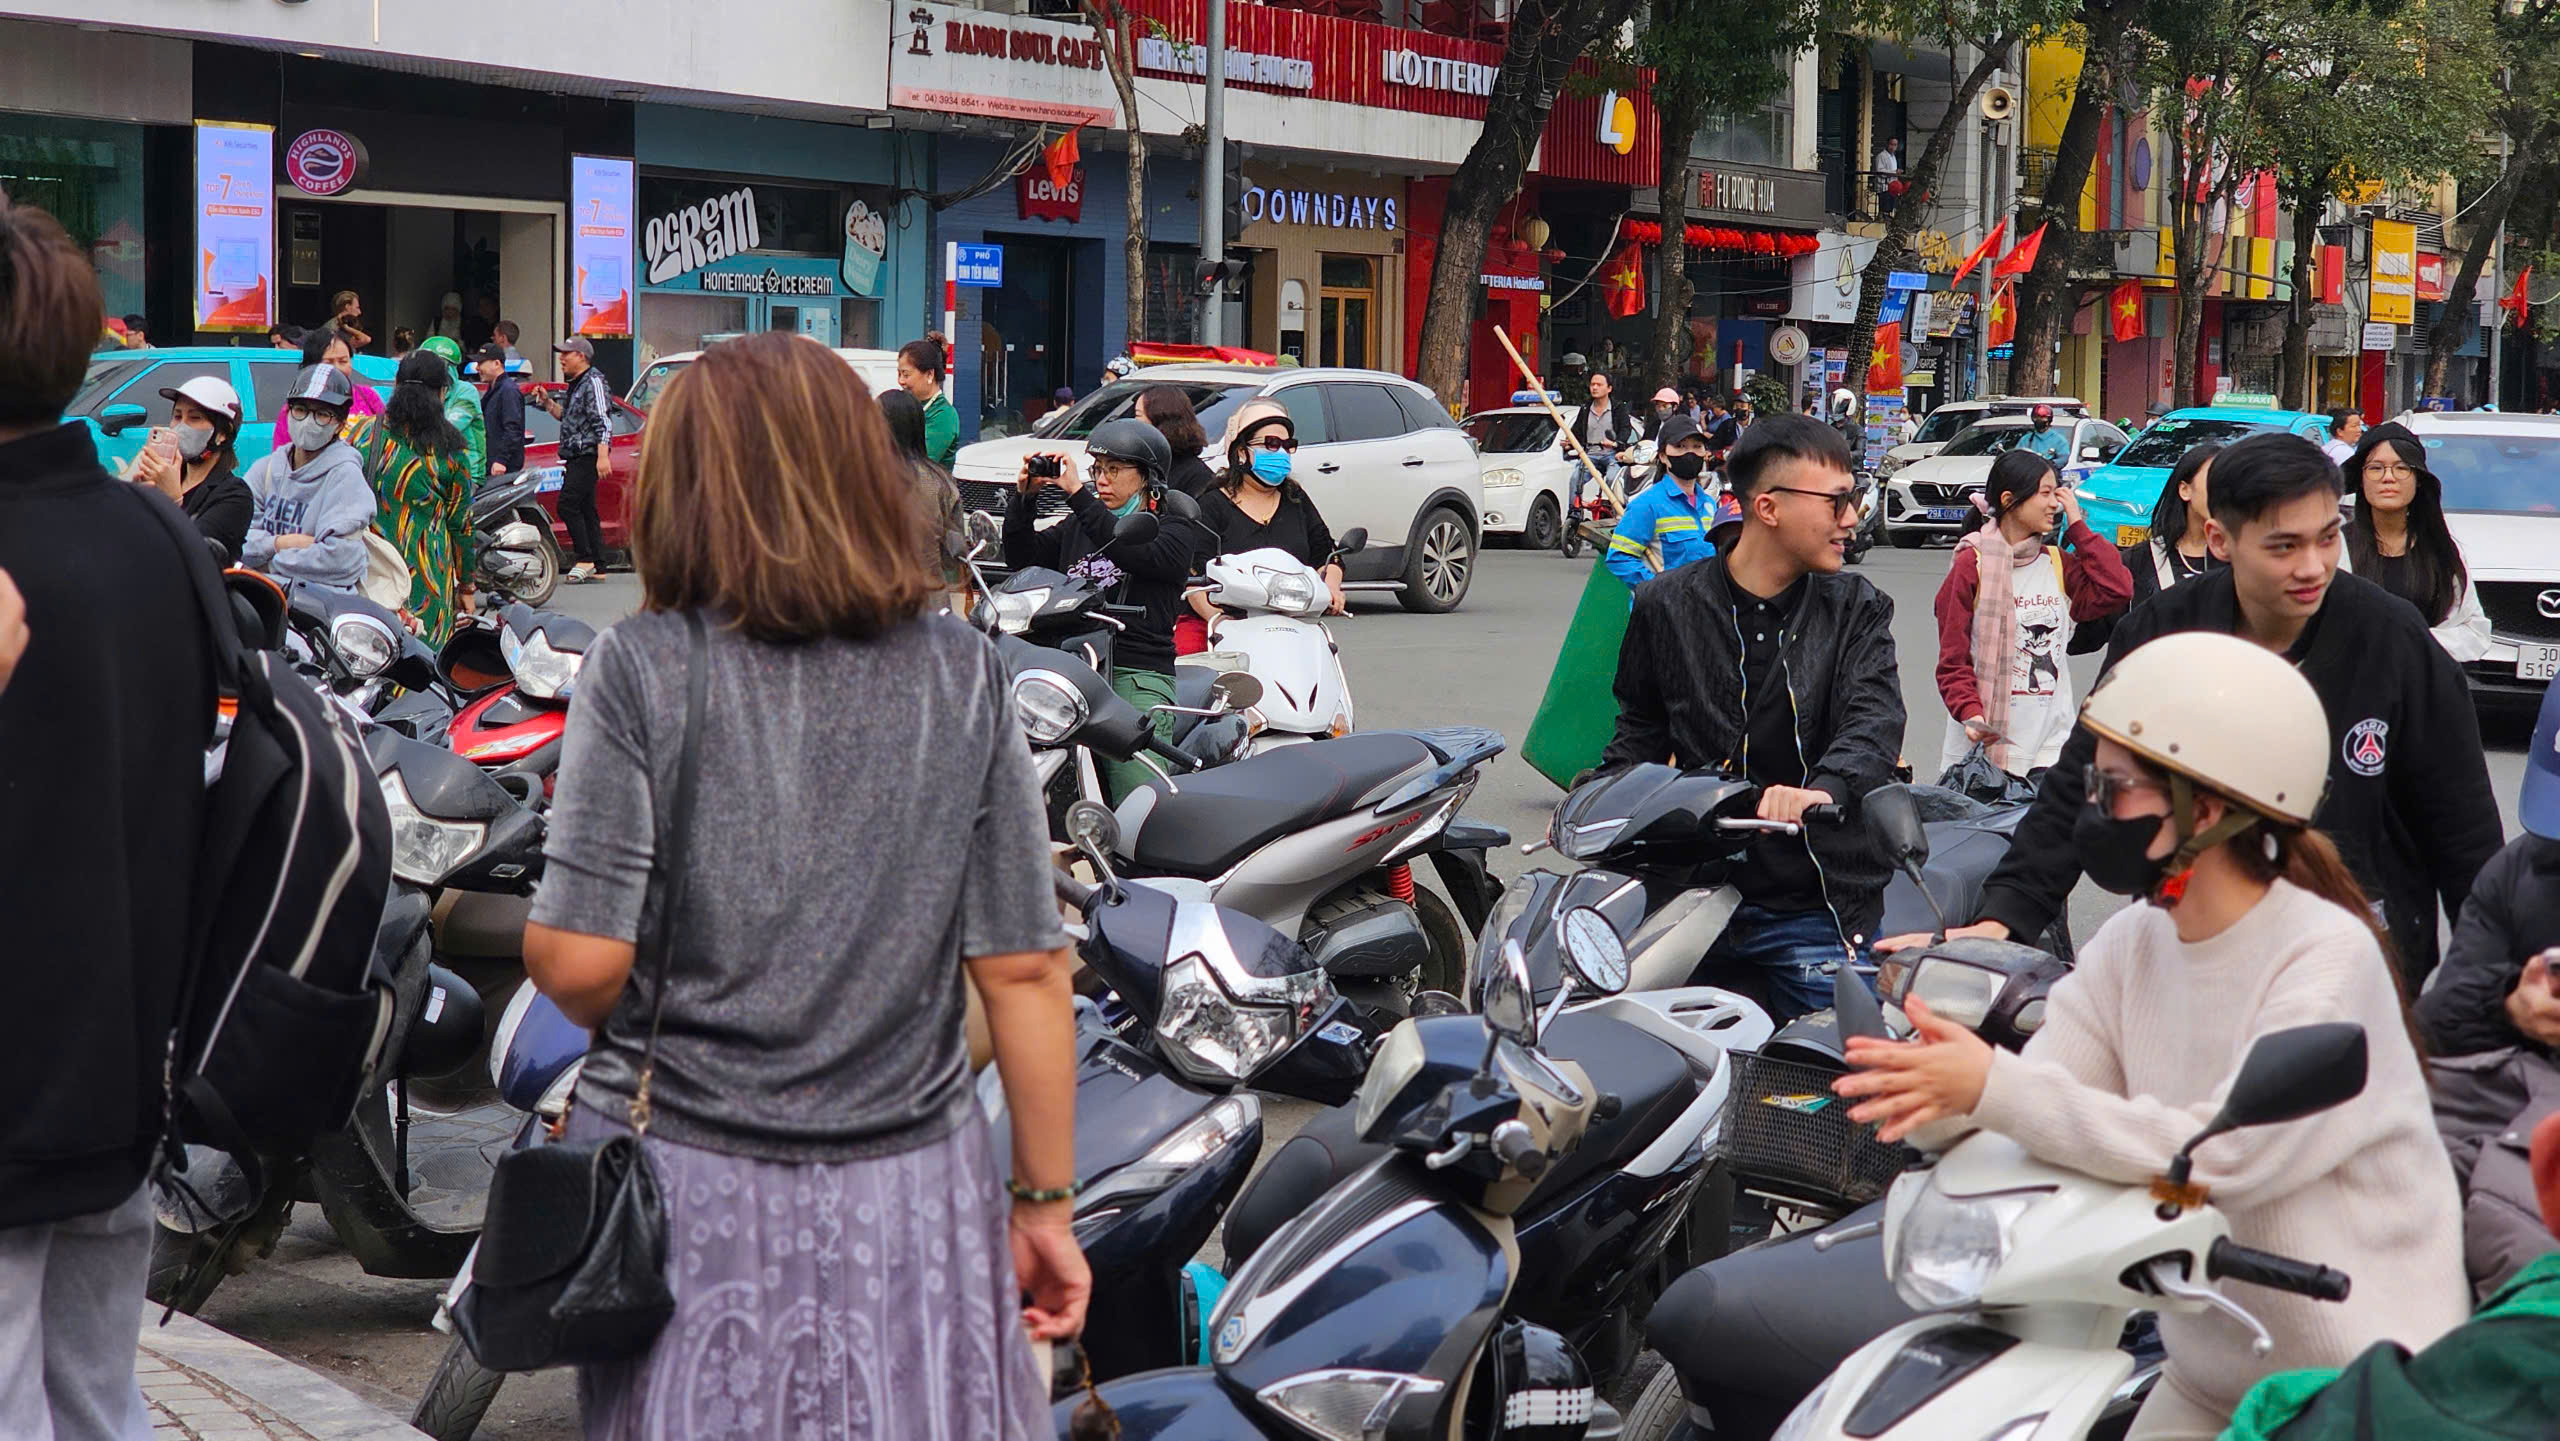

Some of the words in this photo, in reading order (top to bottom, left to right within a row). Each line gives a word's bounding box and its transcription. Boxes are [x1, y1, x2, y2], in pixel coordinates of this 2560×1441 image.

[946, 20, 1008, 59] HANOI
[1009, 29, 1056, 66] SOUL
[290, 133, 352, 160] HIGHLANDS
[218, 174, 232, 201] 7
[298, 174, 345, 191] COFFEE
[1717, 174, 1728, 208] FU
[1731, 176, 1755, 211] RONG
[1757, 179, 1775, 213] HUA
[704, 271, 765, 293] HOMEMADE
[781, 275, 798, 294] ICE
[798, 274, 833, 295] CREAM
[2539, 647, 2559, 661] 30
[2525, 662, 2555, 677] 516
[1098, 1052, 1141, 1082] HONDA
